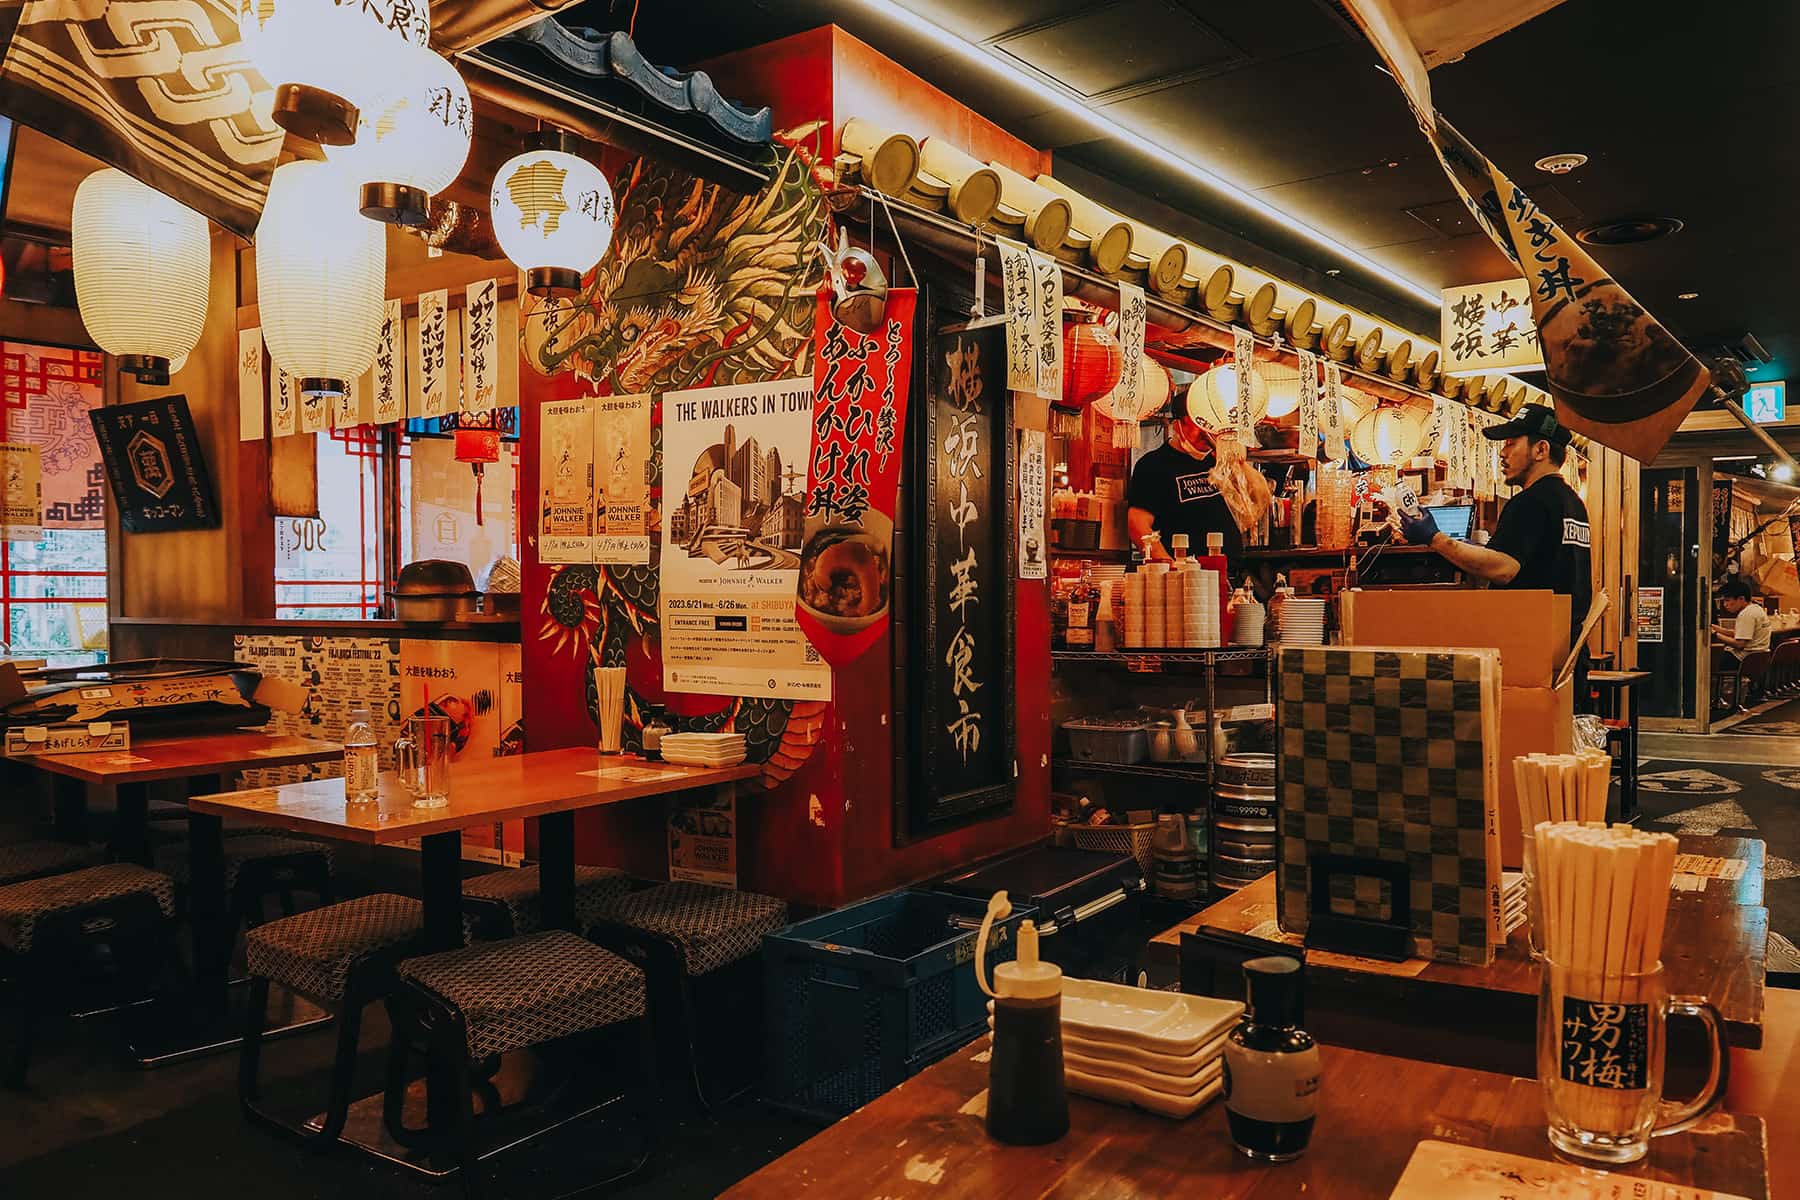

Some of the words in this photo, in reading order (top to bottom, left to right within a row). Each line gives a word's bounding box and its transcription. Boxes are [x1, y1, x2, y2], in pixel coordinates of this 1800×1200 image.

[1450, 291, 1489, 362] 横浜
[1490, 290, 1520, 358] 中華
[676, 402, 697, 422] THE
[701, 396, 758, 420] WALKERS
[762, 394, 776, 414] IN
[808, 321, 844, 526] あんかけ丼
[553, 514, 584, 522] WALKER
[608, 506, 640, 514] JOHNNIE
[608, 513, 640, 521] WALKER
[943, 335, 983, 769] 横浜中華食市
[719, 576, 746, 585] JOHNNIE
[755, 576, 783, 585] WALKER
[406, 665, 455, 679] 大胆を味わおう
[1488, 810, 1497, 836] ビール
[1563, 1016, 1588, 1081] サワー
[1579, 1003, 1628, 1089] 男梅
